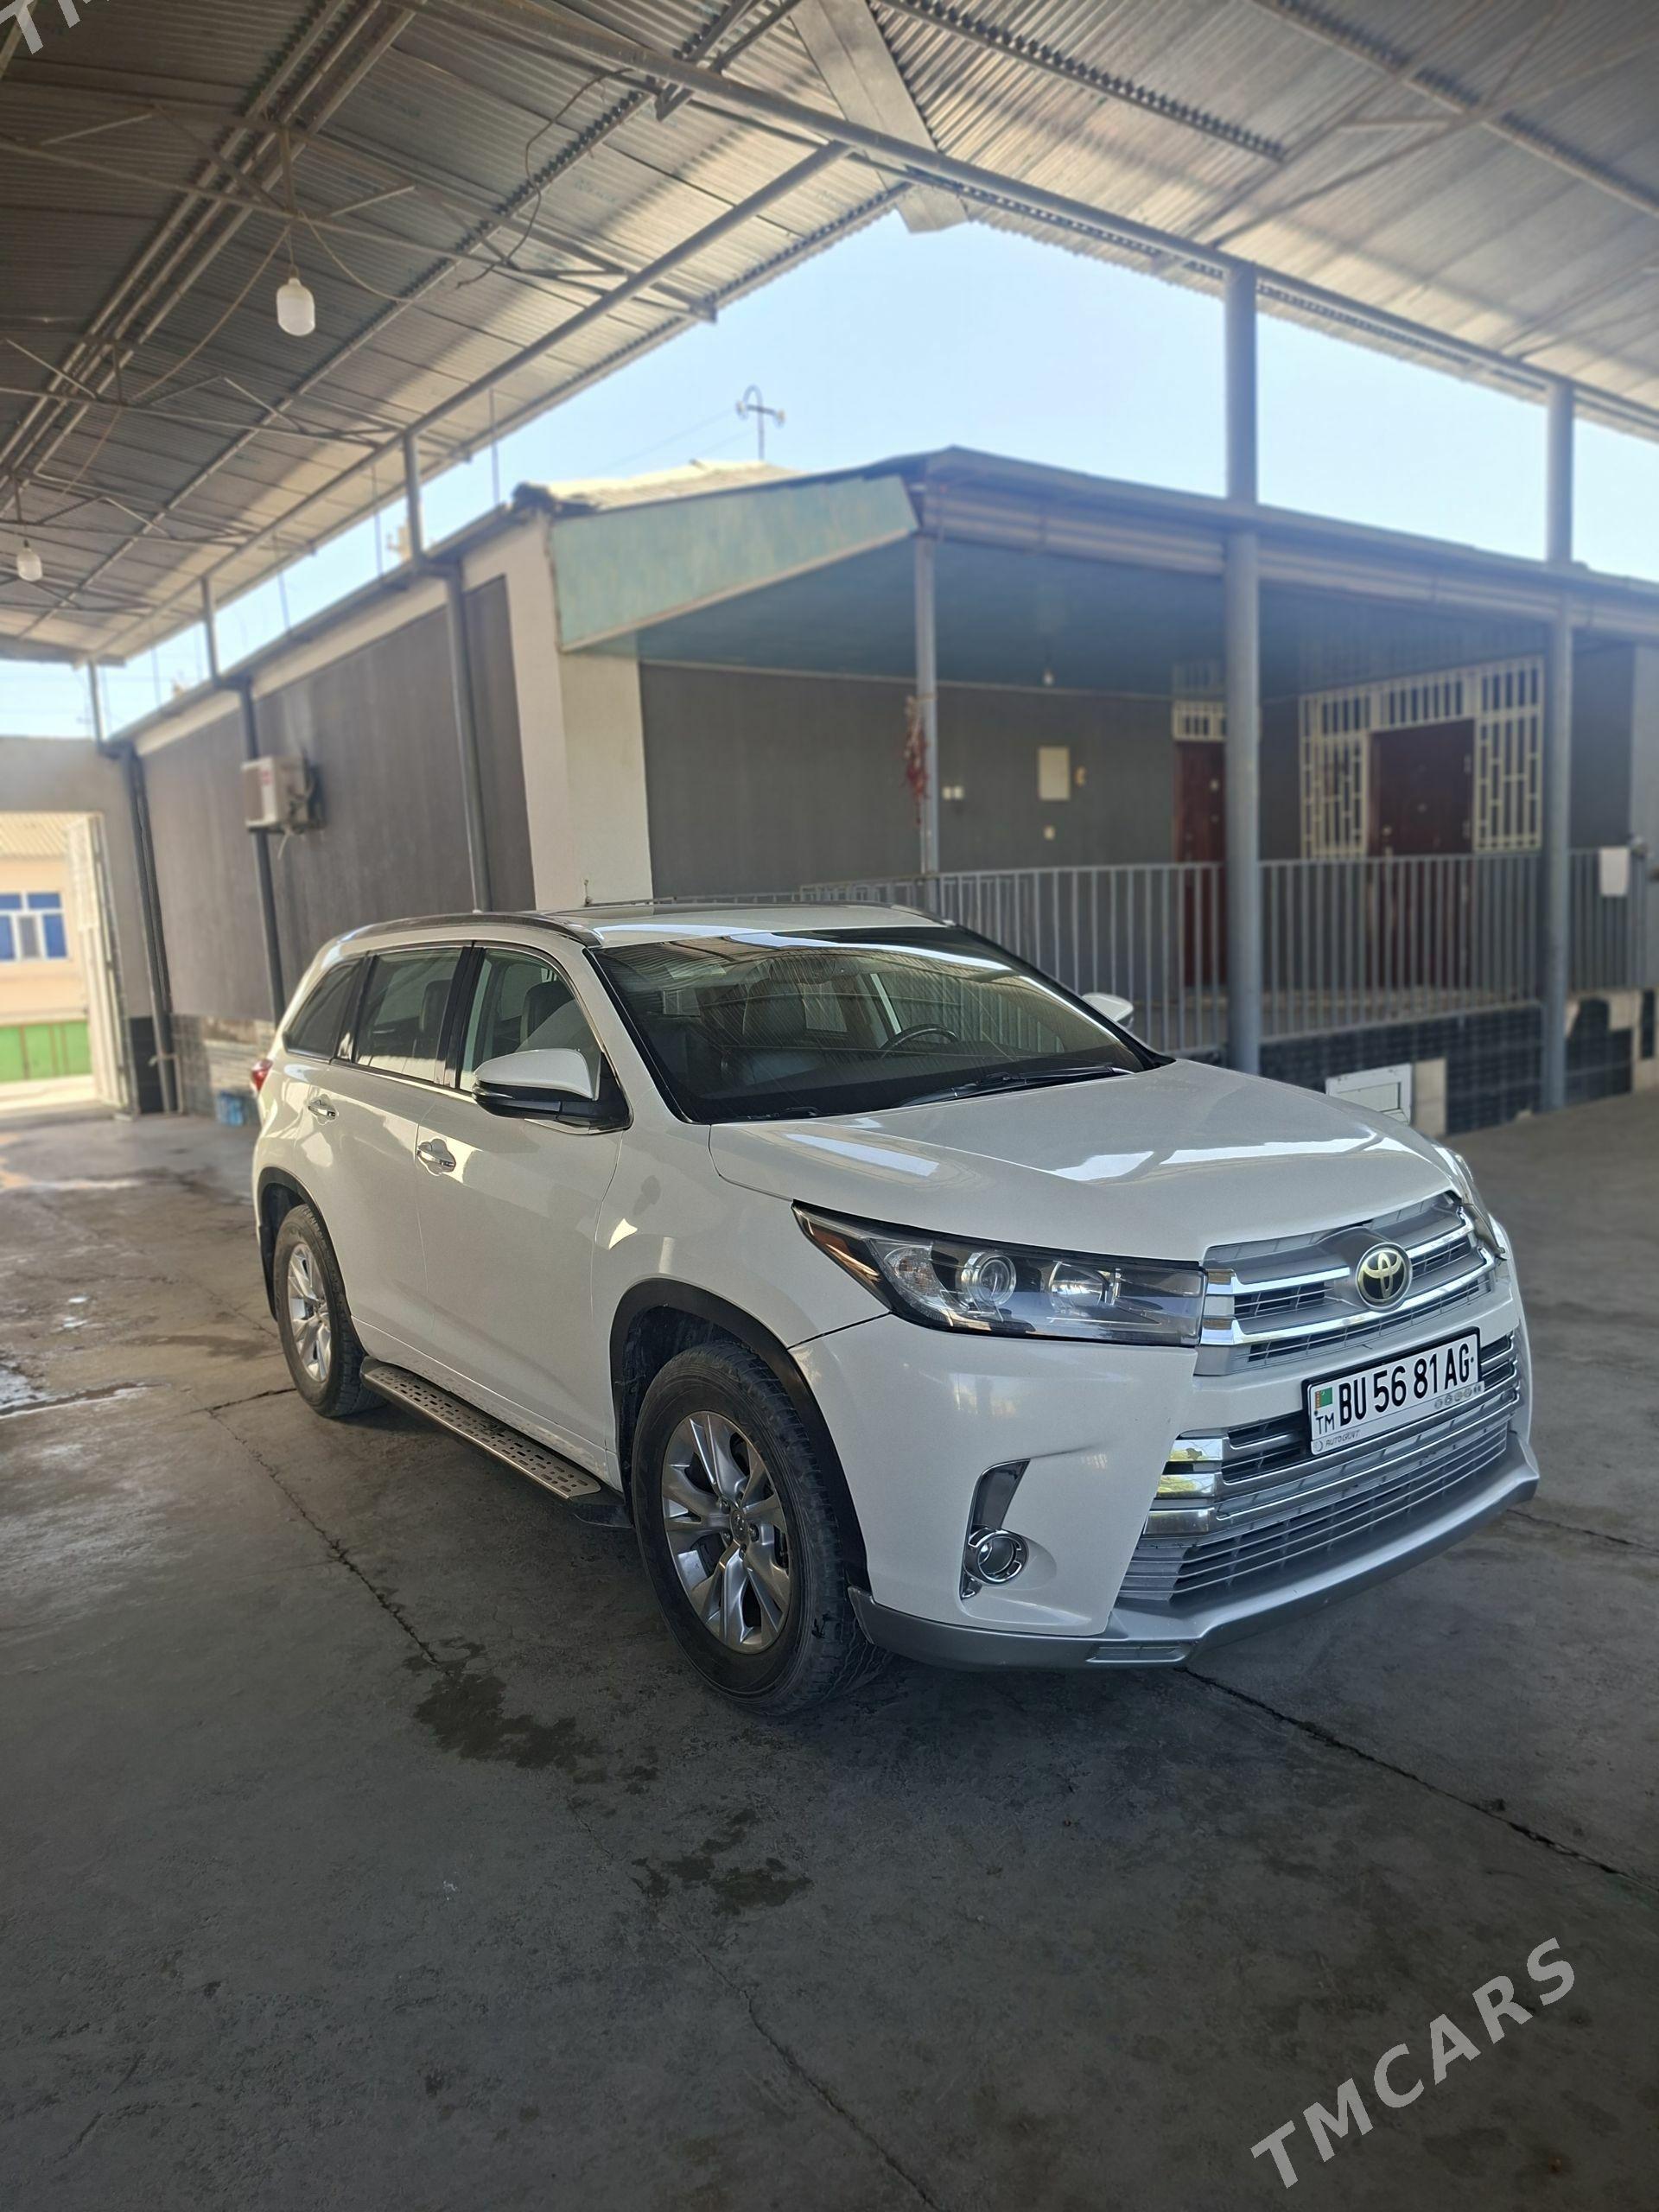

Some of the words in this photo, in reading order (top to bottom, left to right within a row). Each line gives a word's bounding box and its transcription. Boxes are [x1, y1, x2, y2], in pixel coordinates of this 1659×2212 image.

[1339, 1376, 1367, 1426] BU
[1373, 1365, 1407, 1413] 56
[1414, 1353, 1438, 1399] 81
[1444, 1343, 1470, 1390] AG
[1316, 1412, 1335, 1435] TM
